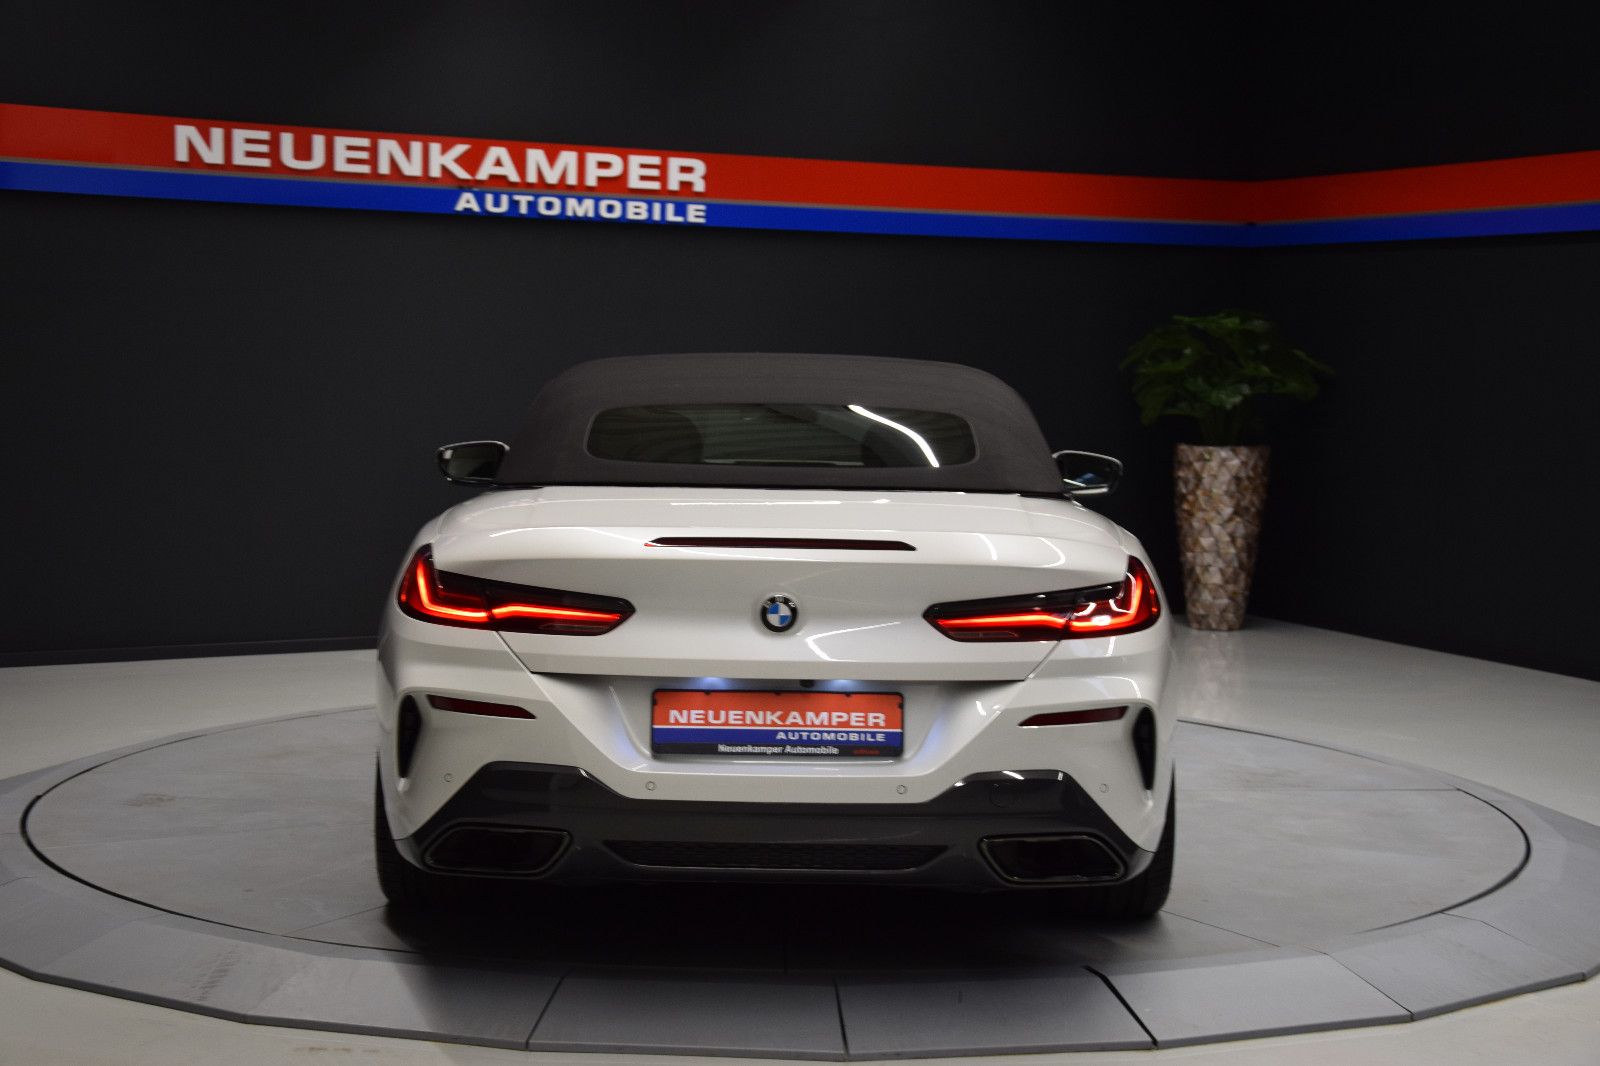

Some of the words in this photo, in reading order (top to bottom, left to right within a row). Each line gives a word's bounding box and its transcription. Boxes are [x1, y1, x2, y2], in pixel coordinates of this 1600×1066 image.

[174, 124, 707, 193] NEUENKAMPER
[455, 192, 707, 224] AUTOMOBILE
[669, 709, 886, 727] NEUENKAMPER
[776, 731, 886, 742] AUTOMOBILE
[718, 744, 783, 755] Neuenkamper
[785, 745, 839, 755] Automobile
